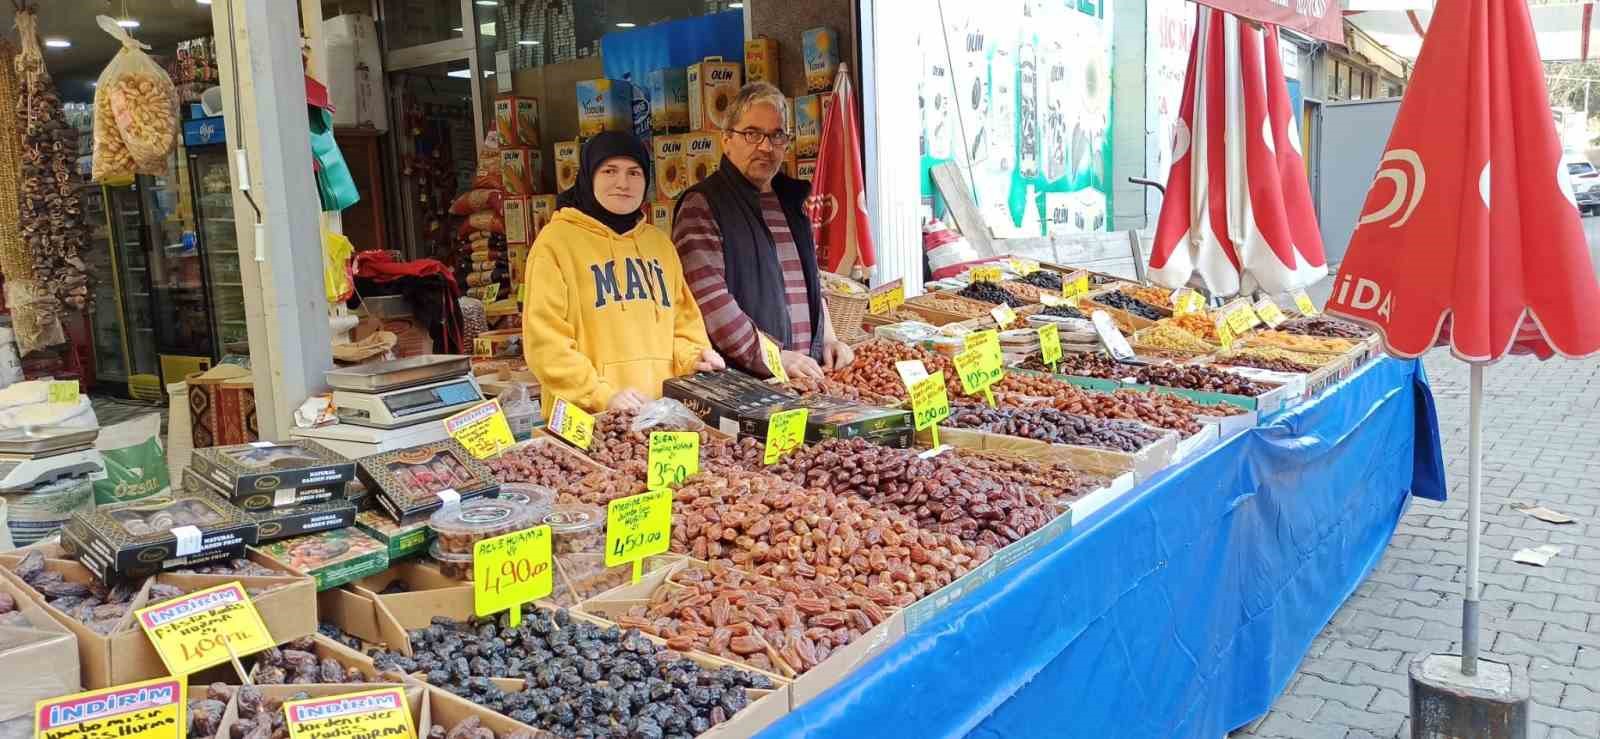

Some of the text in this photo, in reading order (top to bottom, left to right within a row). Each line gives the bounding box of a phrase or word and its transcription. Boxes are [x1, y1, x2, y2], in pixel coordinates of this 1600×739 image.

[711, 68, 733, 81] OLİN
[662, 142, 681, 153] OLİN
[691, 137, 712, 151] OLİN
[151, 590, 235, 624] İNDİRİM
[51, 686, 172, 725] İNDİRİM
[298, 694, 394, 719] İNDİRİM
